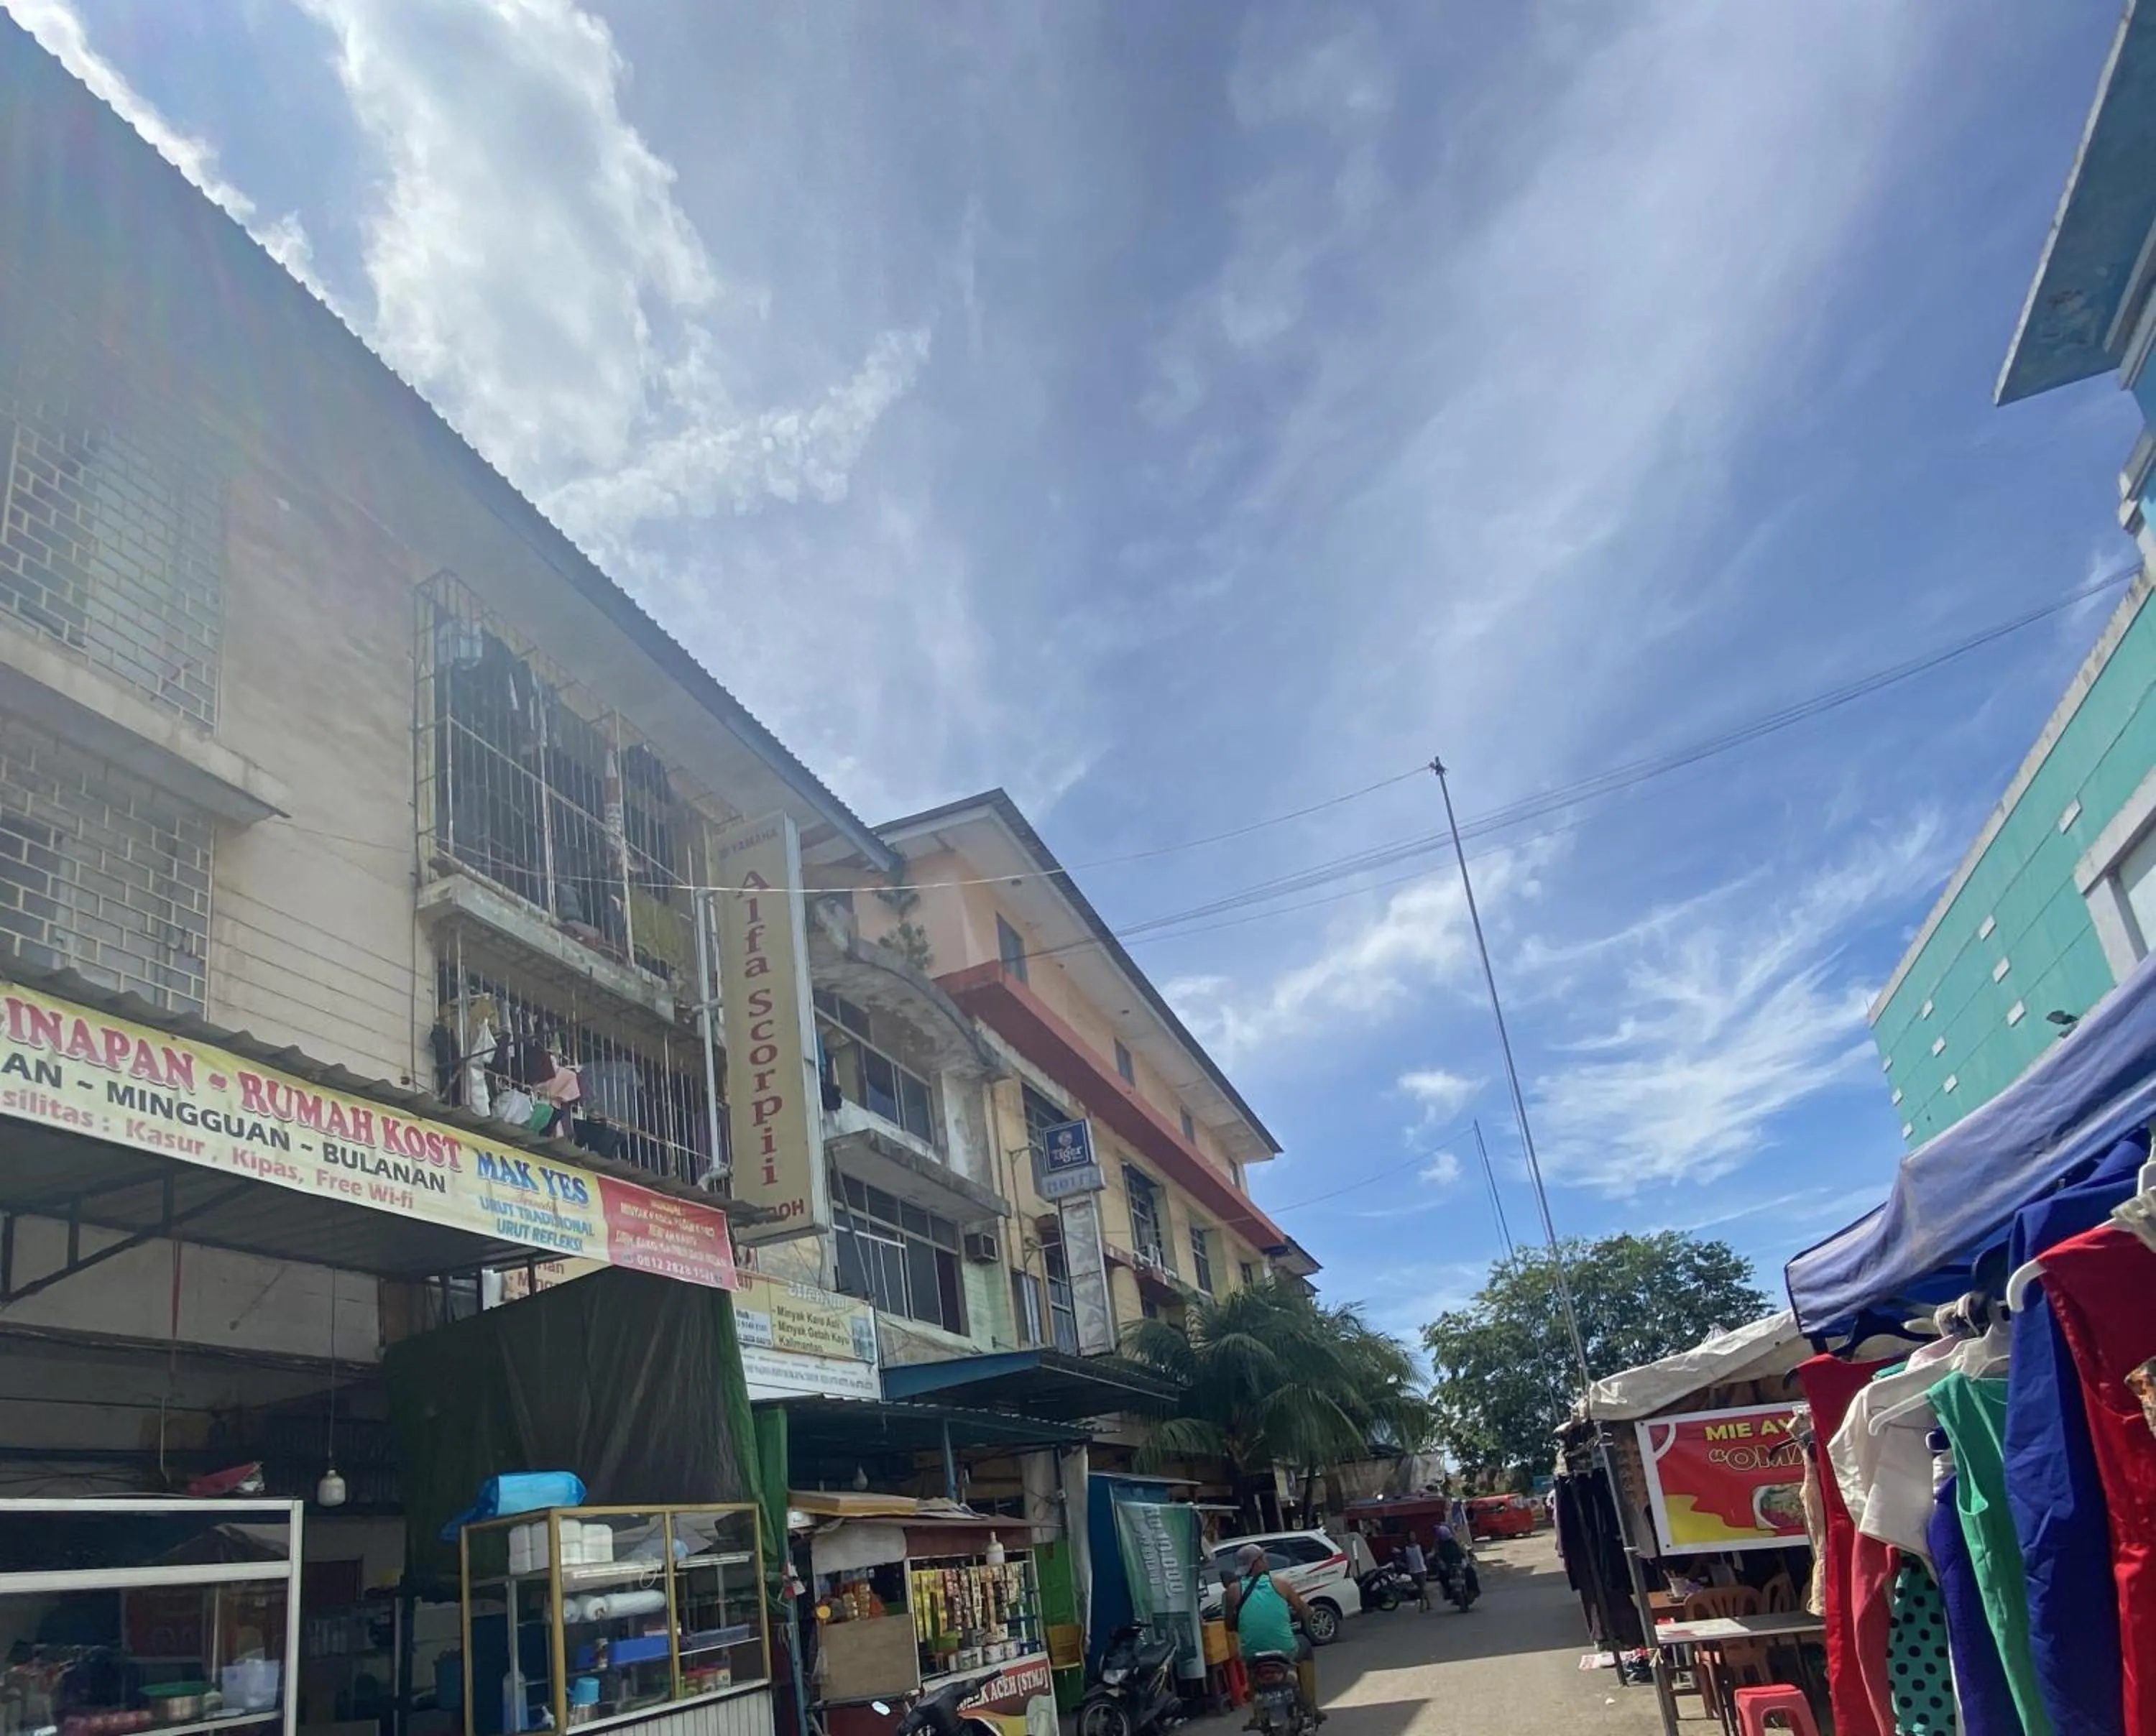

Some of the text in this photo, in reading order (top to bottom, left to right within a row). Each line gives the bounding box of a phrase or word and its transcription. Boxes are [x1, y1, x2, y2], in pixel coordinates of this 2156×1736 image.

[734, 870, 772, 979] Alfa
[0, 997, 196, 1095] INAPAN
[237, 1071, 377, 1148] RUMAH
[381, 1115, 463, 1173] KOST
[748, 988, 783, 1186] Scorpii
[1, 1052, 63, 1089] AN
[107, 1080, 291, 1152] MINGGUAN
[323, 1141, 446, 1194] BULANAN
[316, 1168, 362, 1197] Free
[367, 1181, 414, 1209] Wi-fi
[474, 1148, 539, 1194] MAK
[539, 1166, 590, 1207] YES
[479, 1195, 514, 1217] URUT
[497, 1217, 584, 1253] URUT REFLEKSI
[778, 1321, 808, 1338] Minyak
[778, 1334, 824, 1352] Kalimantan
[1705, 1423, 1753, 1441] MIE
[991, 1674, 1018, 1702] ACEH
